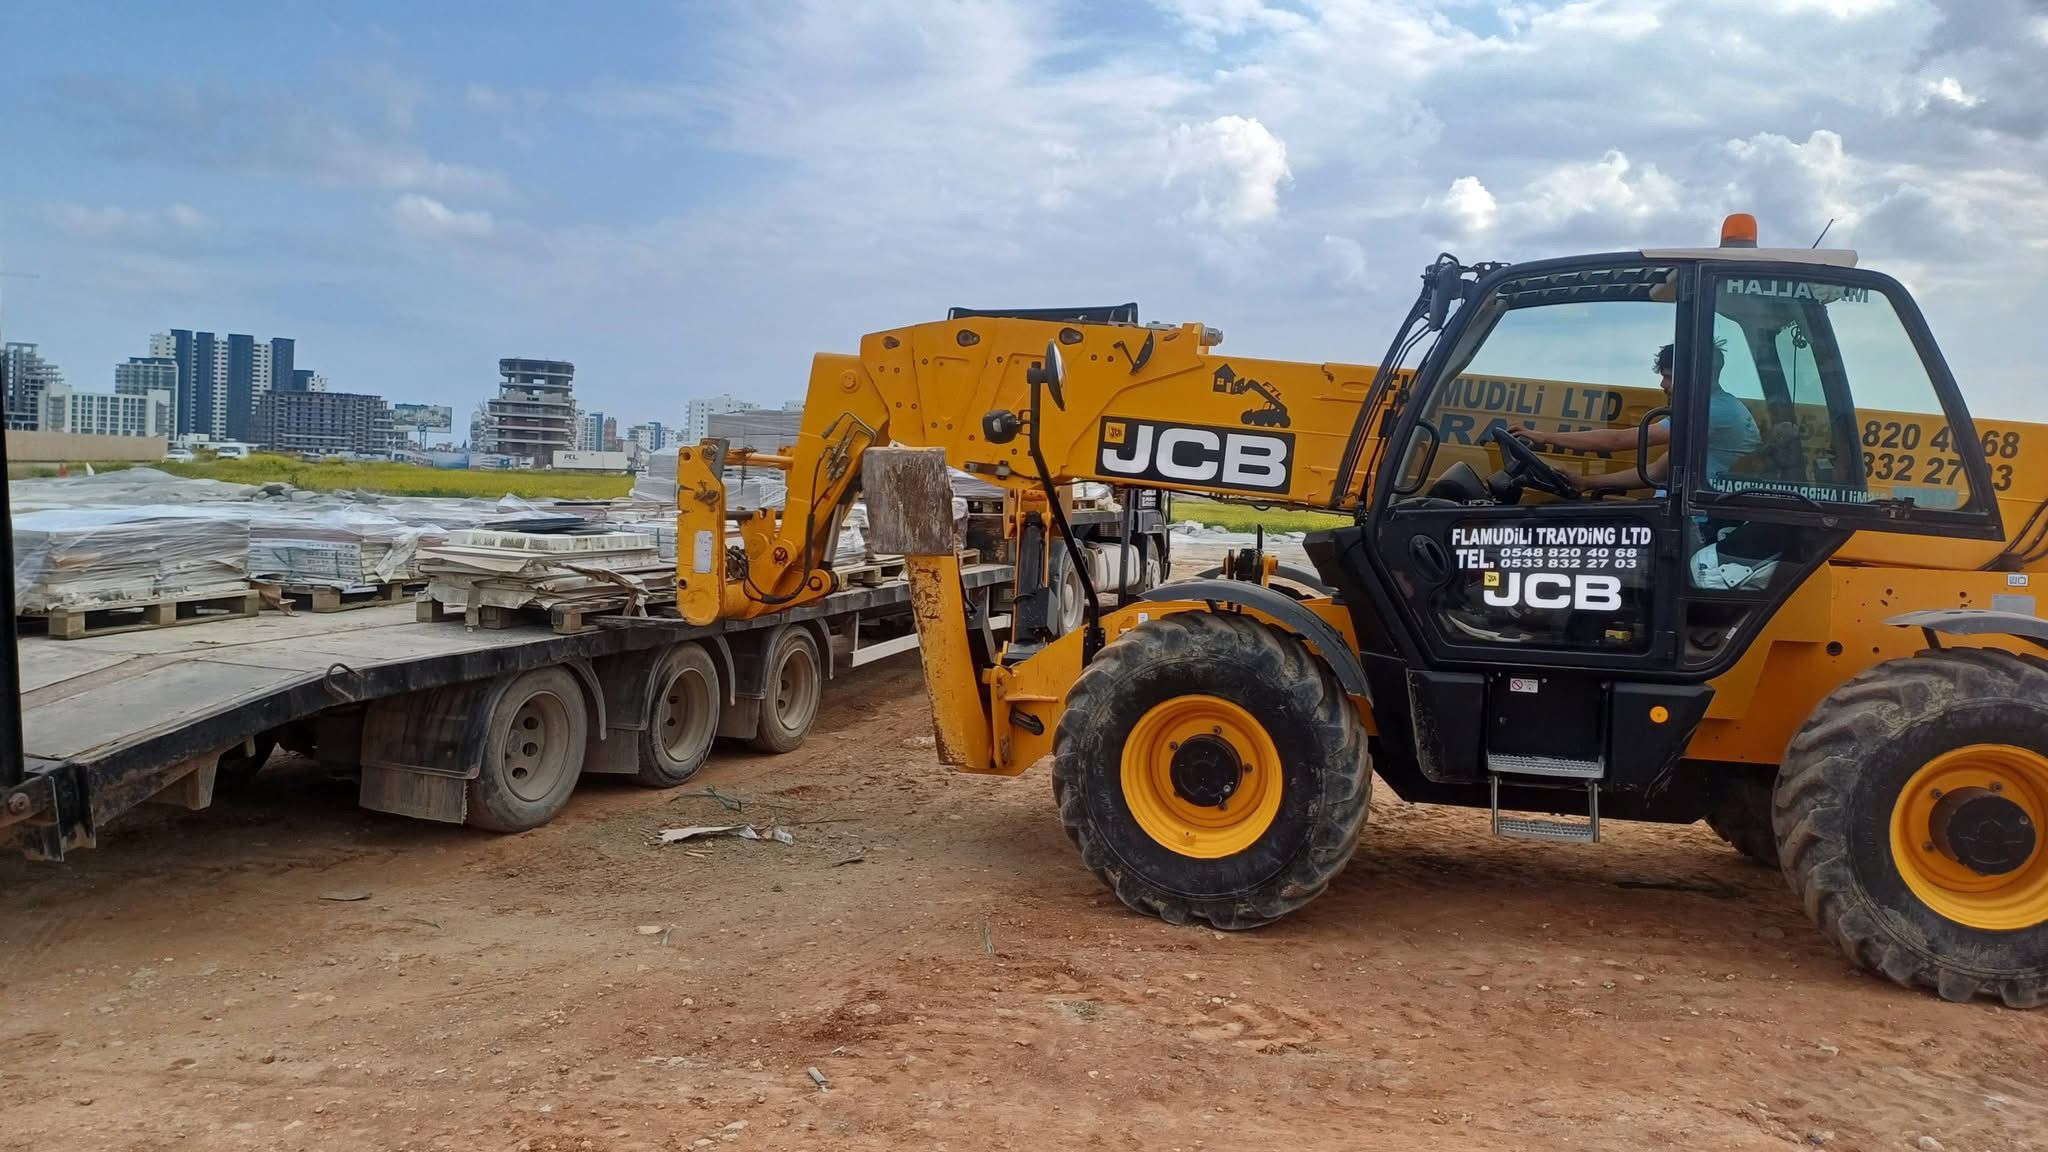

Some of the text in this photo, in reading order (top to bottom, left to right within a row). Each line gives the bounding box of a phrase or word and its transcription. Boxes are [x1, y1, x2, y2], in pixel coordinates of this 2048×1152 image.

[1262, 381, 1281, 400] FTL
[1563, 387, 1623, 421] LTD
[1102, 425, 1287, 487] JCB
[1863, 421, 1921, 450] 820
[1981, 430, 2020, 458] 68
[1923, 457, 1964, 485] 27
[1986, 463, 2013, 491] 3
[1621, 528, 1651, 545] LTD
[1456, 548, 1637, 569] TEL. 0548 820 40 68
[1500, 559, 1637, 568] 0533 832 27 03
[1484, 573, 1622, 611] JCB
